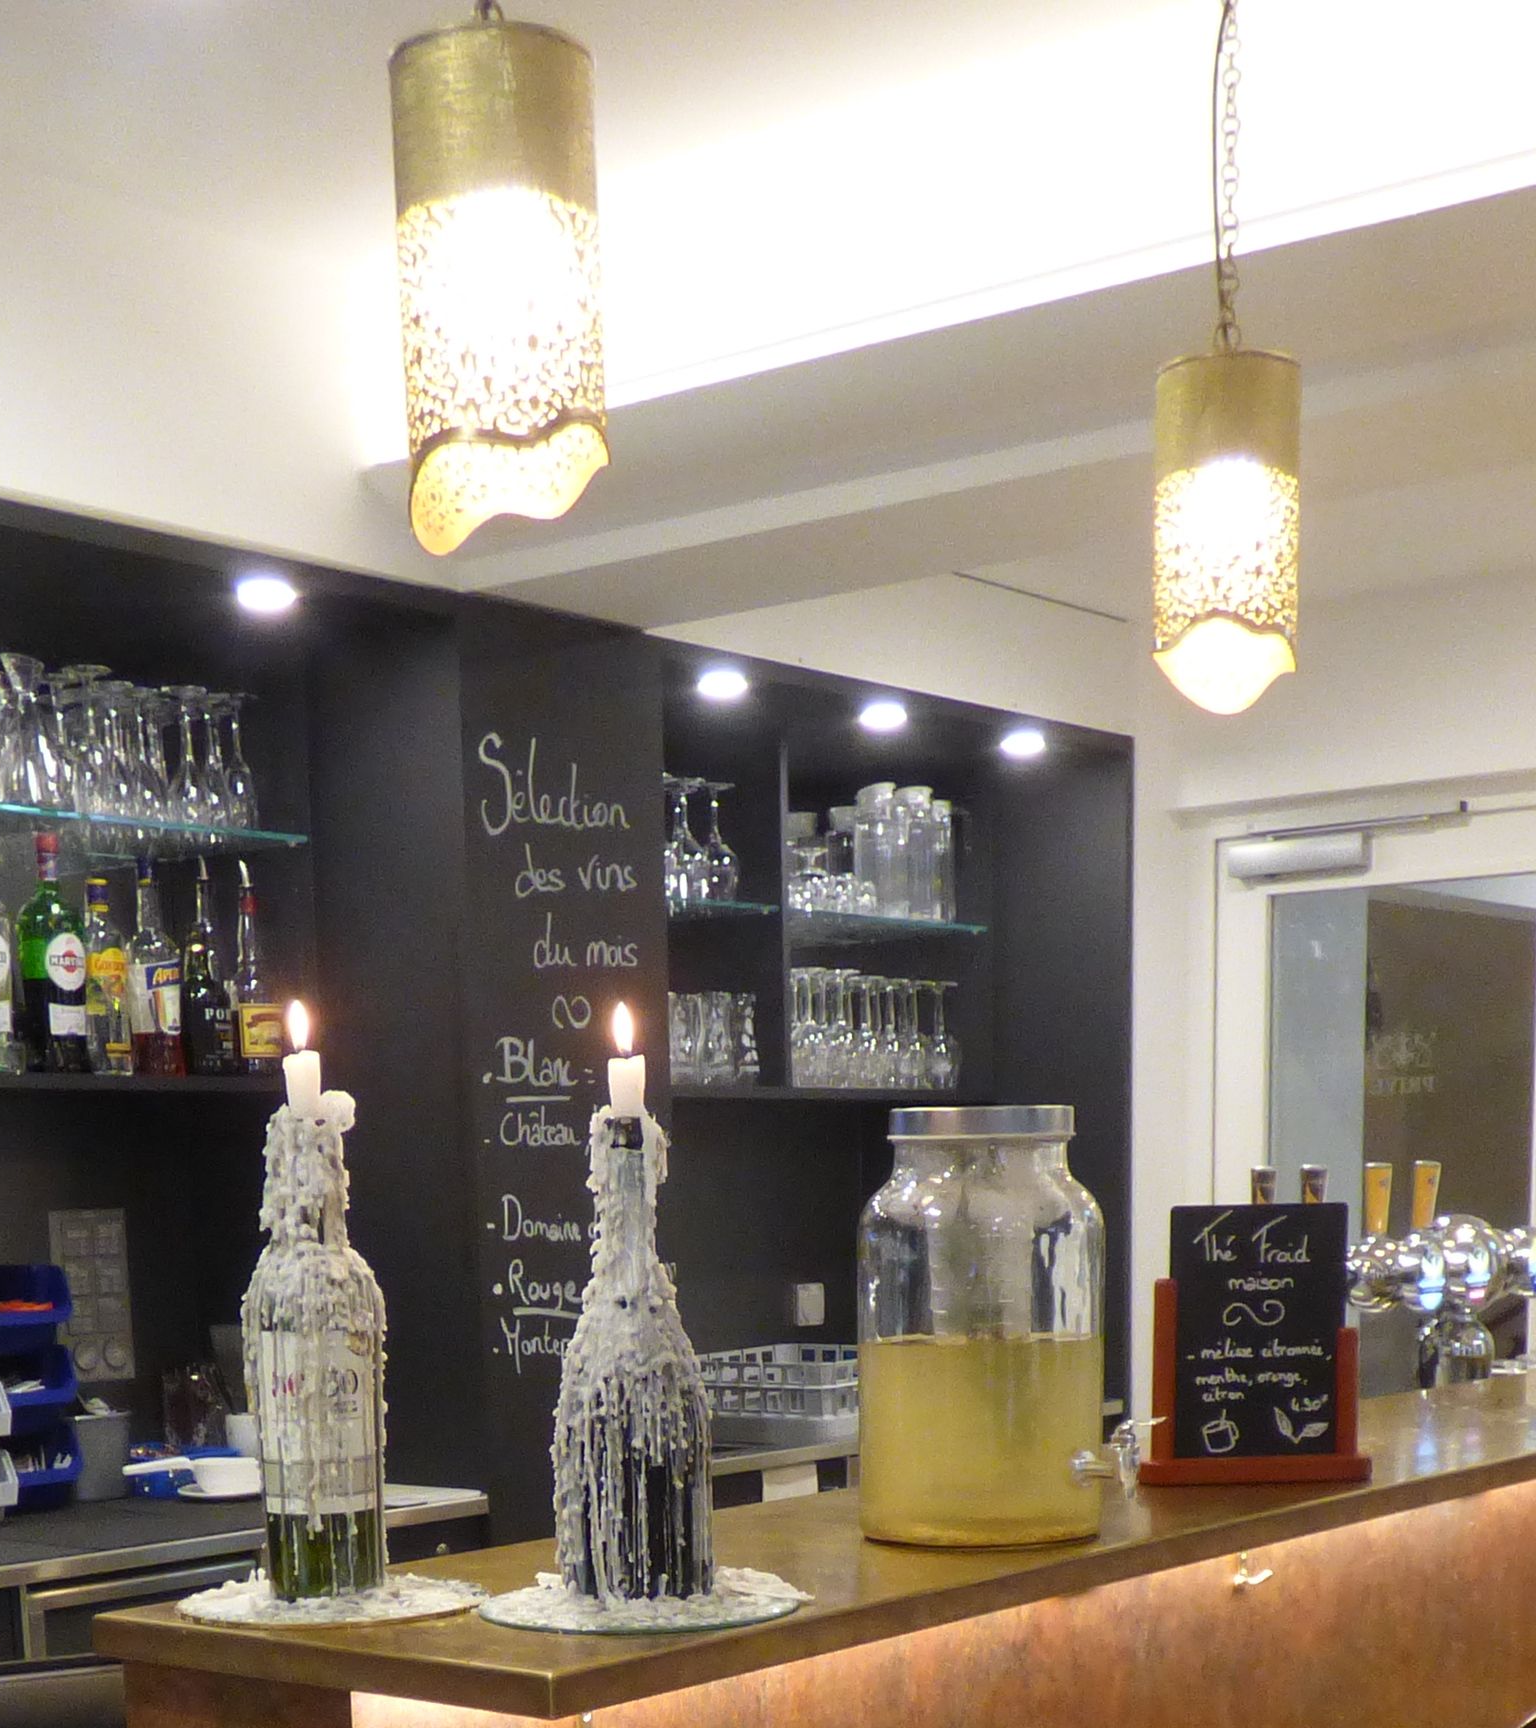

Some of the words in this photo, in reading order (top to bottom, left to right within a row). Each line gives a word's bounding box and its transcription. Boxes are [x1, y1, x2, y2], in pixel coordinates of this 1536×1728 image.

[478, 732, 632, 837] Sélection
[515, 842, 565, 899] des
[578, 854, 638, 892] vins
[533, 911, 577, 969] du
[586, 935, 638, 968] mois
[499, 1105, 582, 1147] Château
[501, 1193, 582, 1242] Domaine
[1192, 1209, 1238, 1261] Thé
[1251, 1215, 1311, 1264] Froid
[1228, 1271, 1295, 1292] maison
